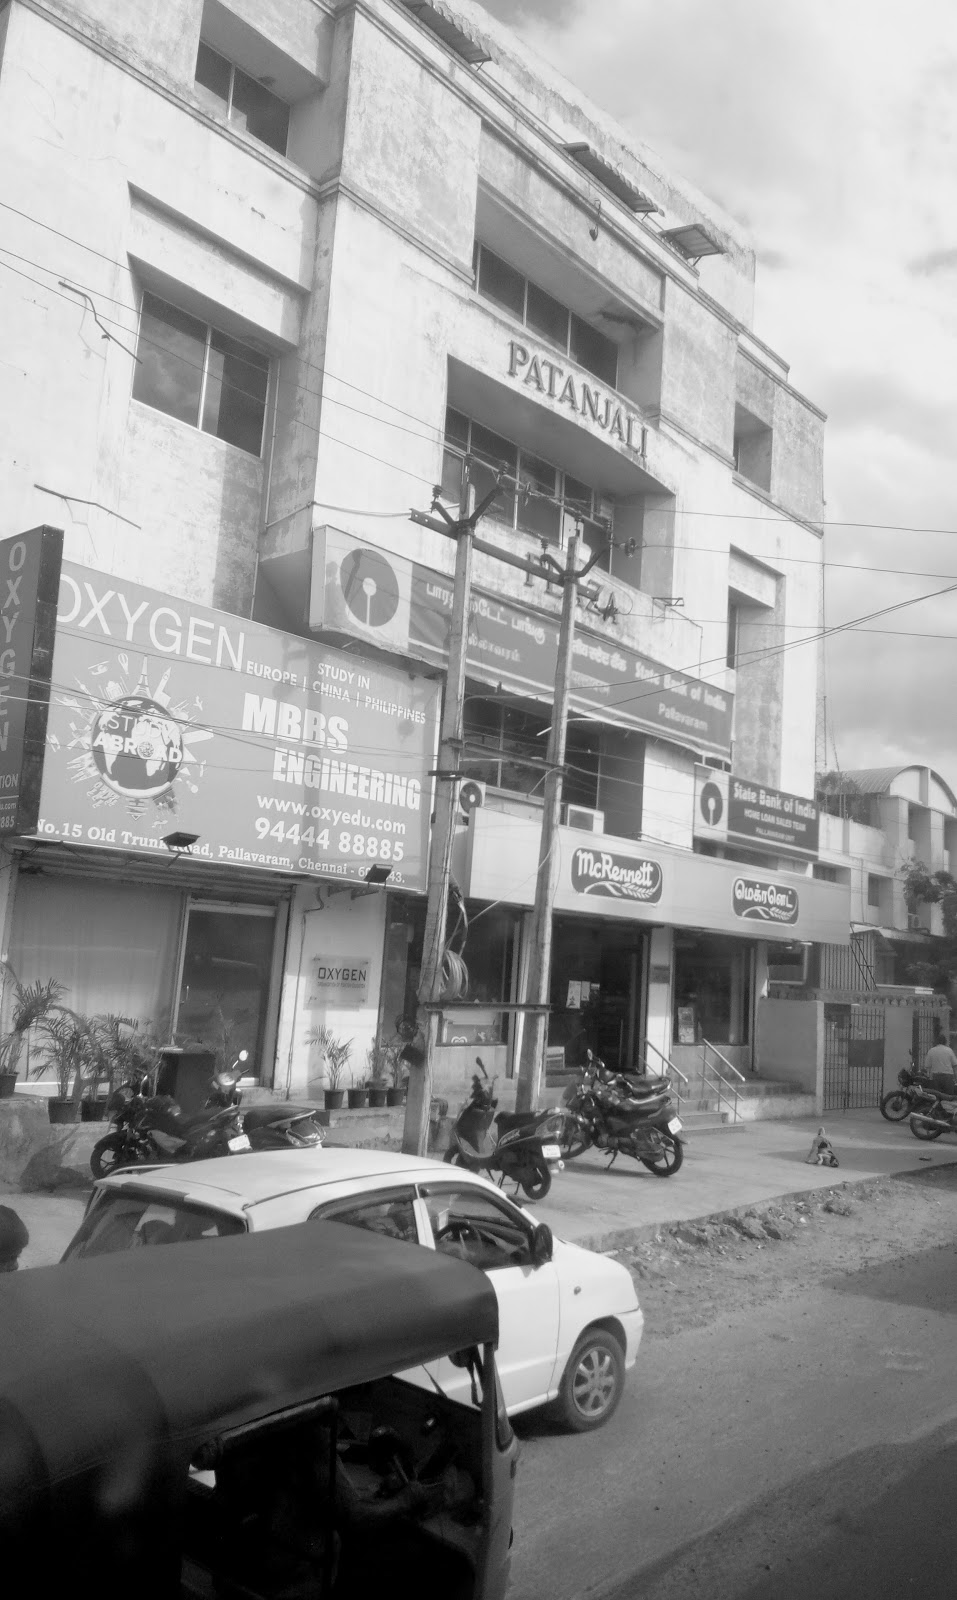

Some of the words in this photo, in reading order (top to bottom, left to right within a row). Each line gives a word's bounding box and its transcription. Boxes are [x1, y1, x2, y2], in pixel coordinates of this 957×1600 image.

[508, 339, 650, 460] PATANJALI
[56, 573, 246, 672] OXYGEN
[246, 660, 298, 686] EUROPE
[312, 680, 351, 703] CHINA
[364, 695, 426, 725] PHILIPPINES
[317, 662, 356, 685] STUDY
[357, 674, 371, 690] IN
[241, 692, 349, 755] MBBS
[272, 746, 422, 811] ENGINEERING
[734, 781, 757, 804] State
[759, 789, 782, 811] Bank
[783, 798, 794, 813] of
[795, 799, 817, 820] India
[256, 795, 406, 835] www.oxyedu.com
[87, 826, 116, 843] Old
[218, 845, 295, 870] Pallavaram,
[298, 857, 348, 875] Chennai
[255, 816, 330, 850] 94444
[338, 831, 405, 862] 88885
[576, 849, 654, 887] McRennett
[318, 967, 366, 981] OXYGEN
